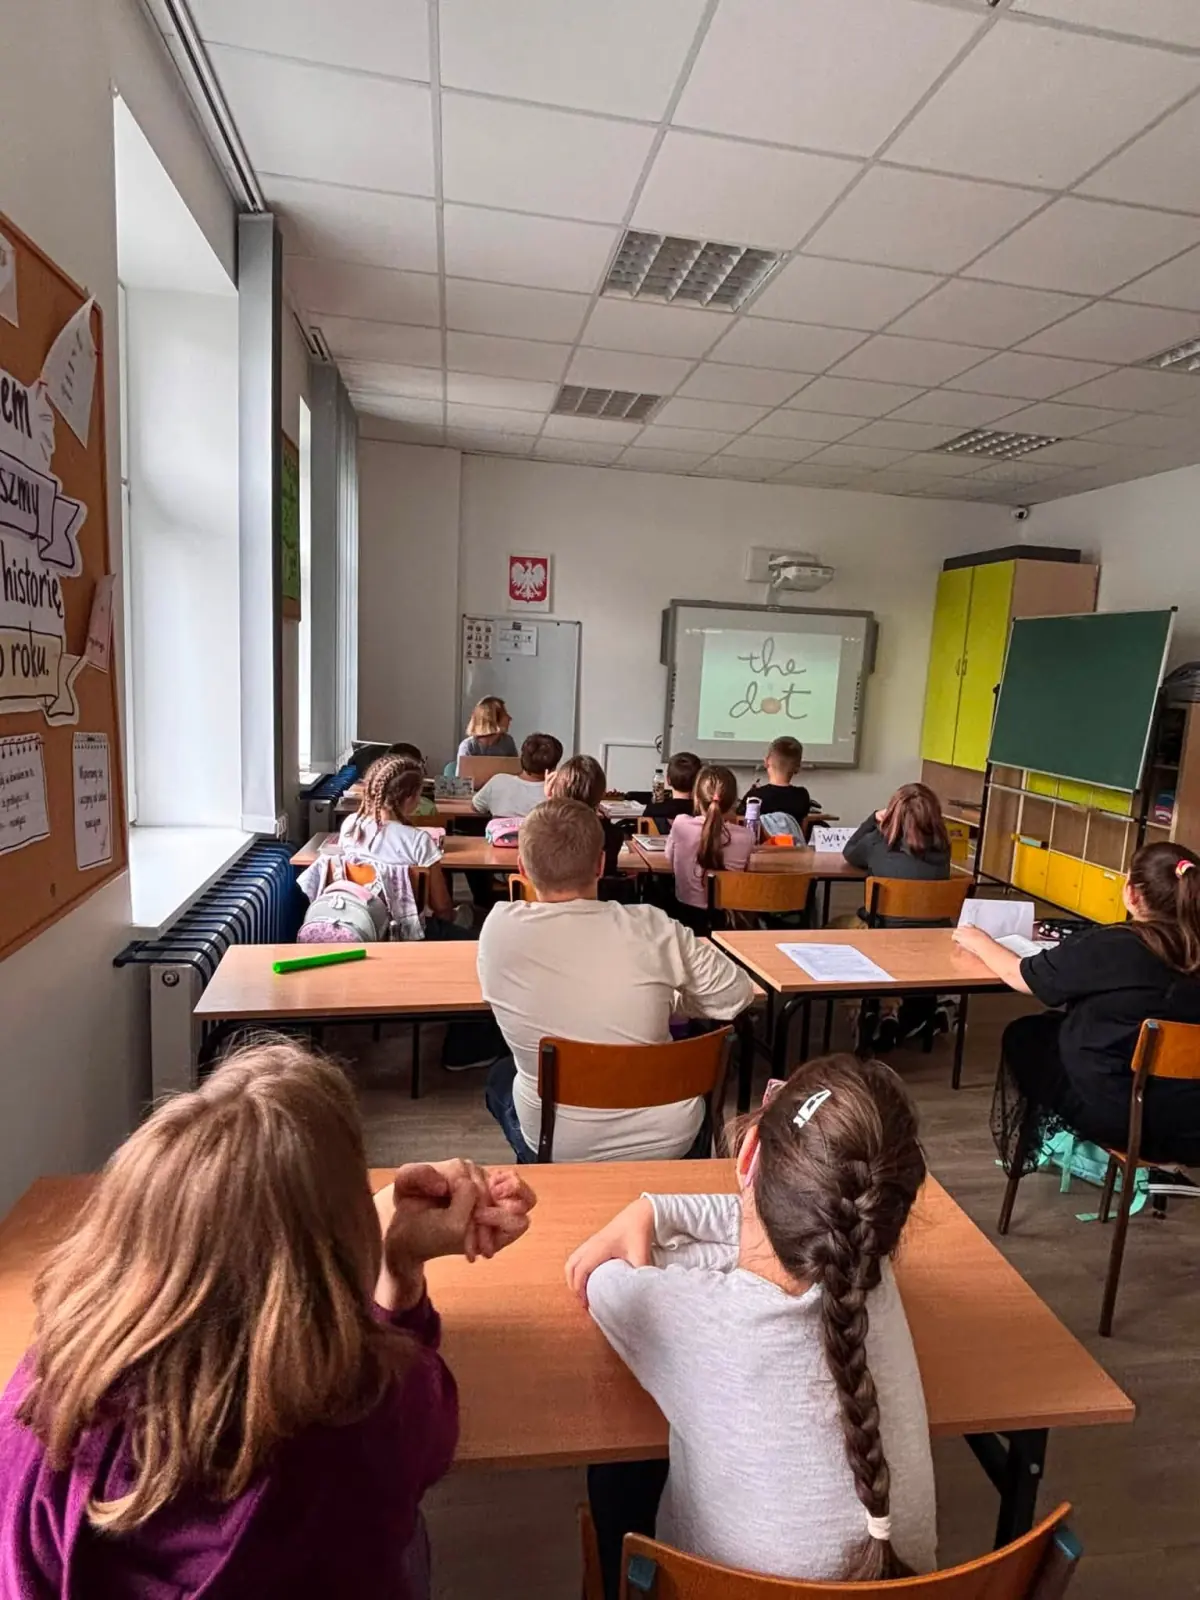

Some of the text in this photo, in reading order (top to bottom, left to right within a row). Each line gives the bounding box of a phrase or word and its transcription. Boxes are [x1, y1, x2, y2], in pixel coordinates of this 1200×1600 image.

[0, 377, 33, 439] em
[0, 467, 39, 540] szmy
[0, 540, 64, 619] historię
[11, 621, 50, 679] roku.
[737, 637, 807, 677] the
